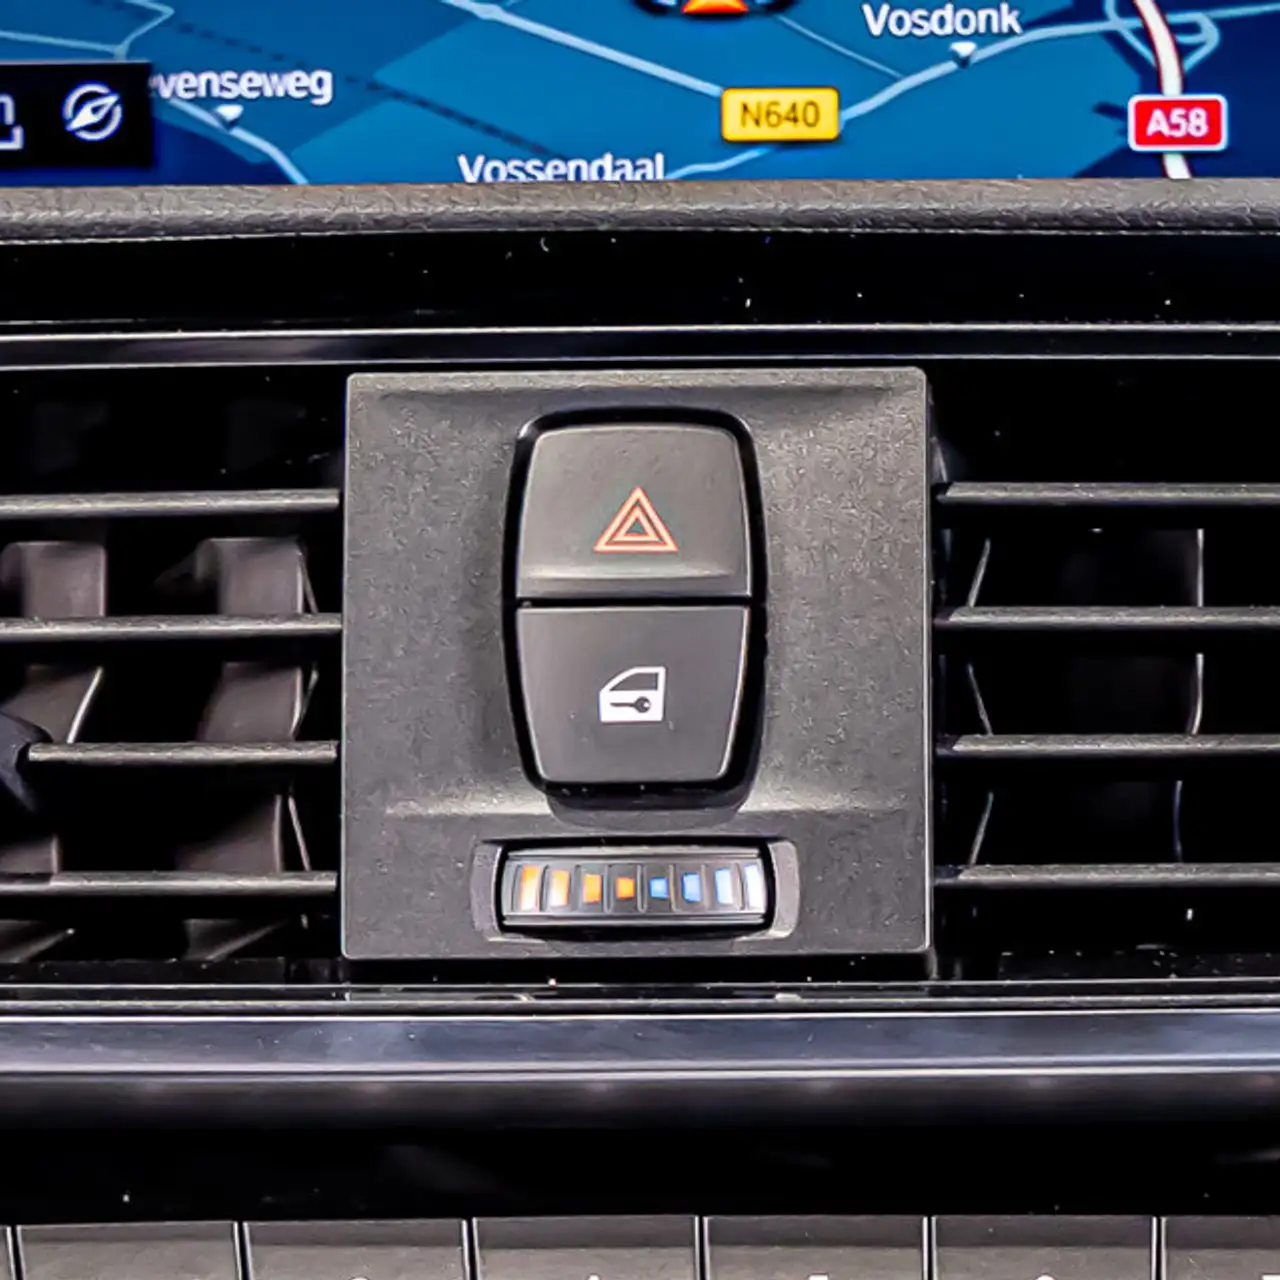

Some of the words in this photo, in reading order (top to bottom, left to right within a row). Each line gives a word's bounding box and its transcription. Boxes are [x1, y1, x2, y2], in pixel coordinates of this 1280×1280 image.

[862, 2, 1023, 37] Vosdonk
[742, 101, 819, 127] N640
[1147, 108, 1208, 137] A58
[458, 153, 666, 181] Vossendaal
